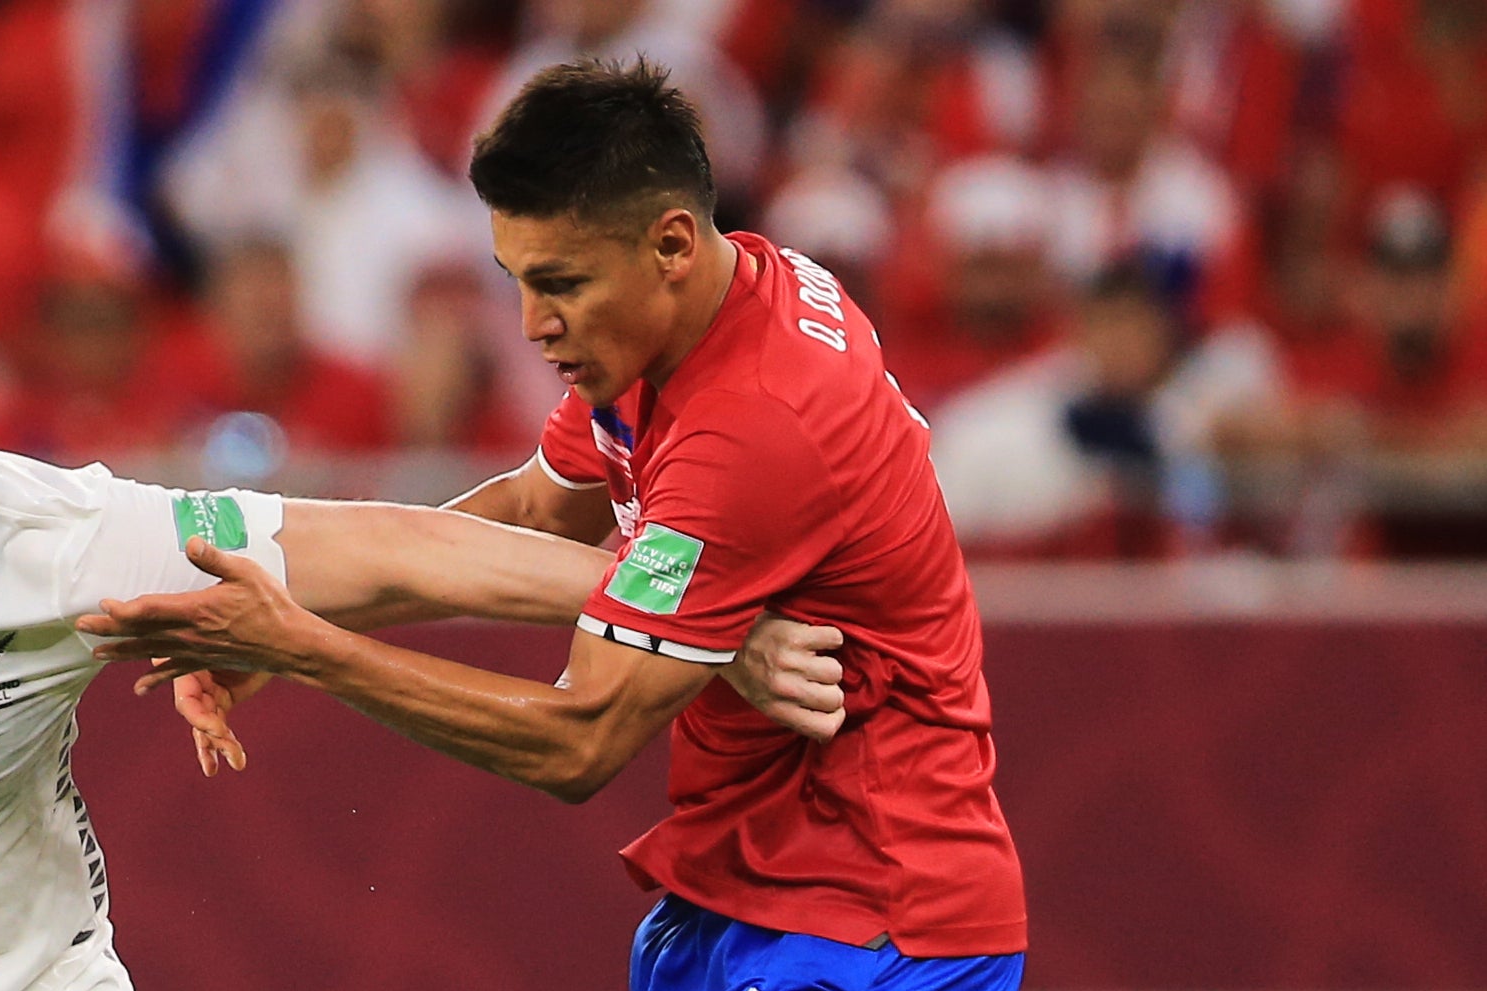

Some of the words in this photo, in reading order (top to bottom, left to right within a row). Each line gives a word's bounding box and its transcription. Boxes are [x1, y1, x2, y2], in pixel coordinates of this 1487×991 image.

[798, 317, 848, 352] O.
[635, 541, 688, 569] LIVING
[648, 577, 677, 596] FIFA
